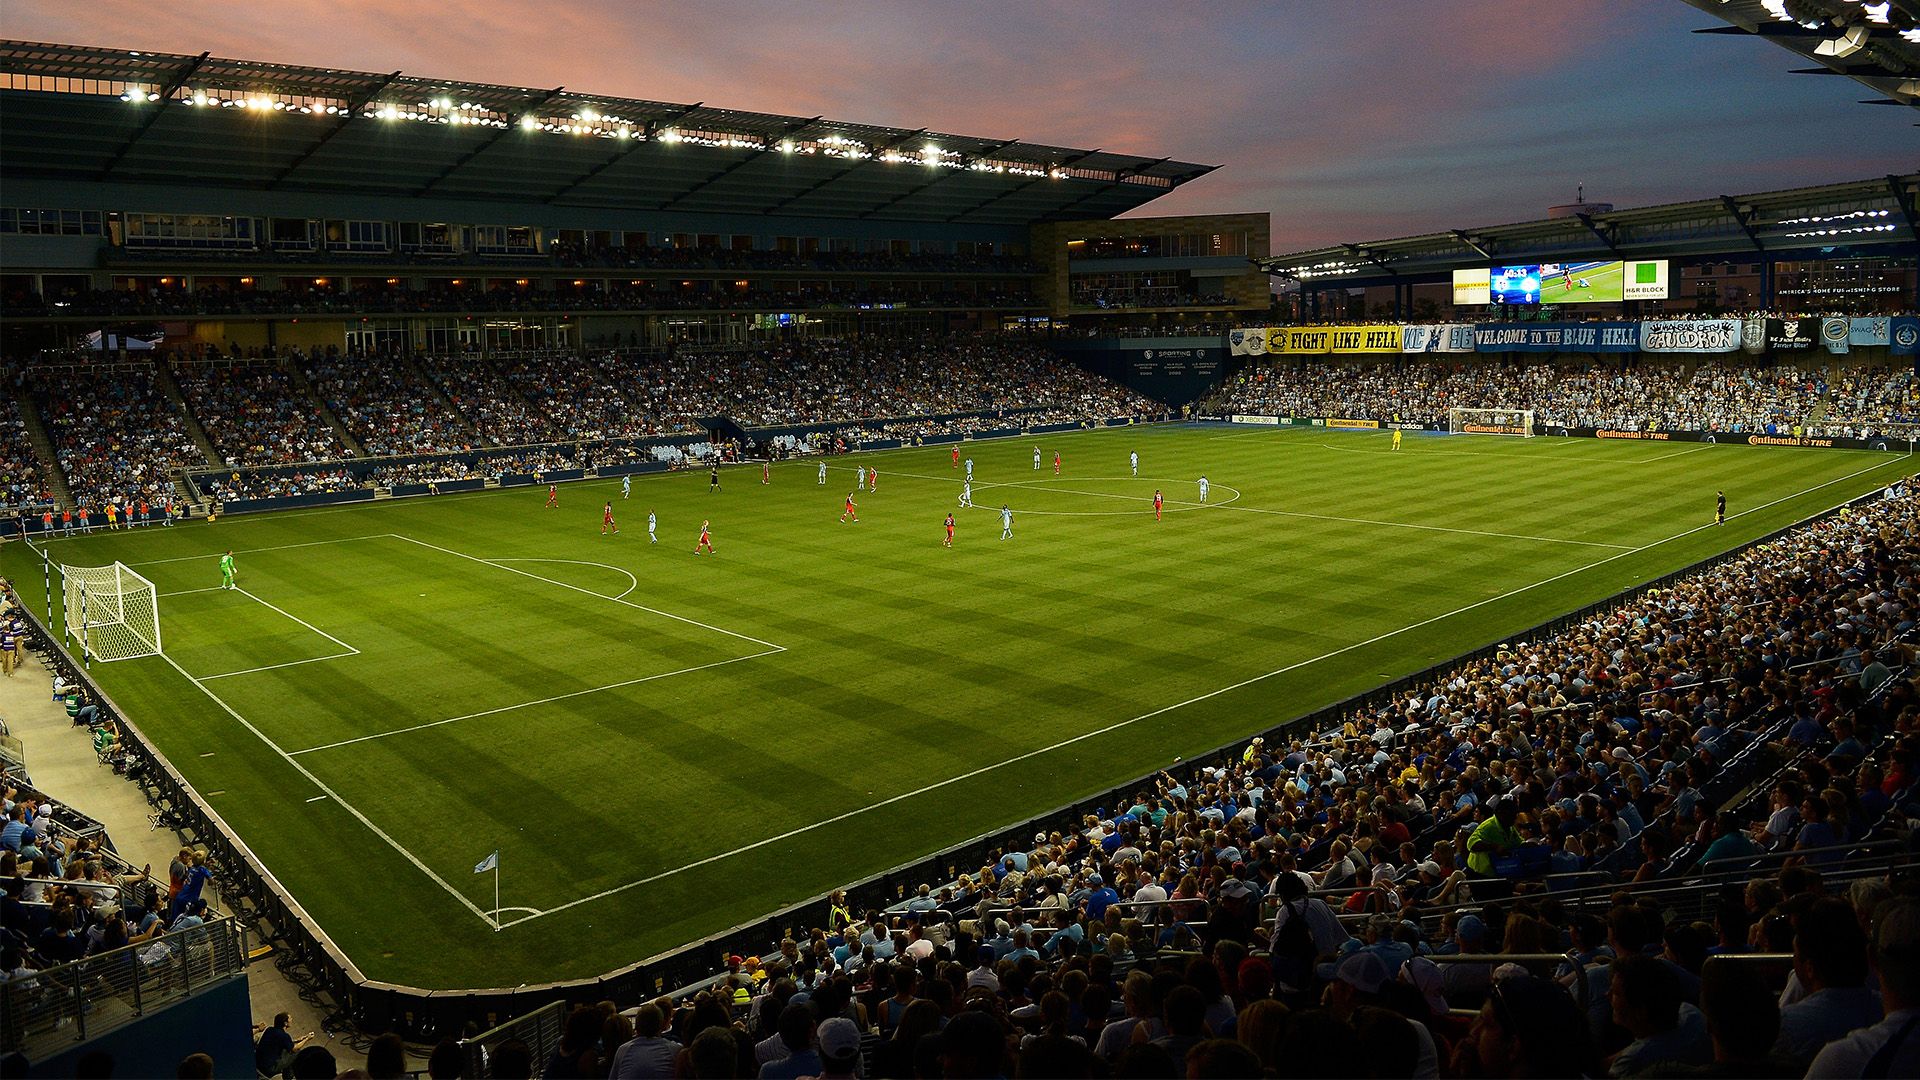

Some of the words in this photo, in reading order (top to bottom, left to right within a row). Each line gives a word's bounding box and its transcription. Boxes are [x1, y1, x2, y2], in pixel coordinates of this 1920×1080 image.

[1497, 294, 1504, 303] 2
[1697, 323, 1720, 332] CITY
[1291, 332, 1328, 349] FIGHT
[1333, 331, 1361, 349] LIKE
[1365, 331, 1398, 348] HELL
[1450, 327, 1475, 349] 96
[1475, 329, 1527, 345] WELCOME
[1531, 331, 1541, 343] TO
[1563, 328, 1595, 345] BLUE
[1602, 328, 1637, 345] HELL
[1646, 330, 1735, 349] CAULDRON
[1401, 422, 1424, 430] adidas
[1463, 424, 1503, 433] Continental
[1596, 429, 1641, 439] Continental
[1748, 435, 1800, 446] Continental
[1810, 439, 1832, 447] TIRE
